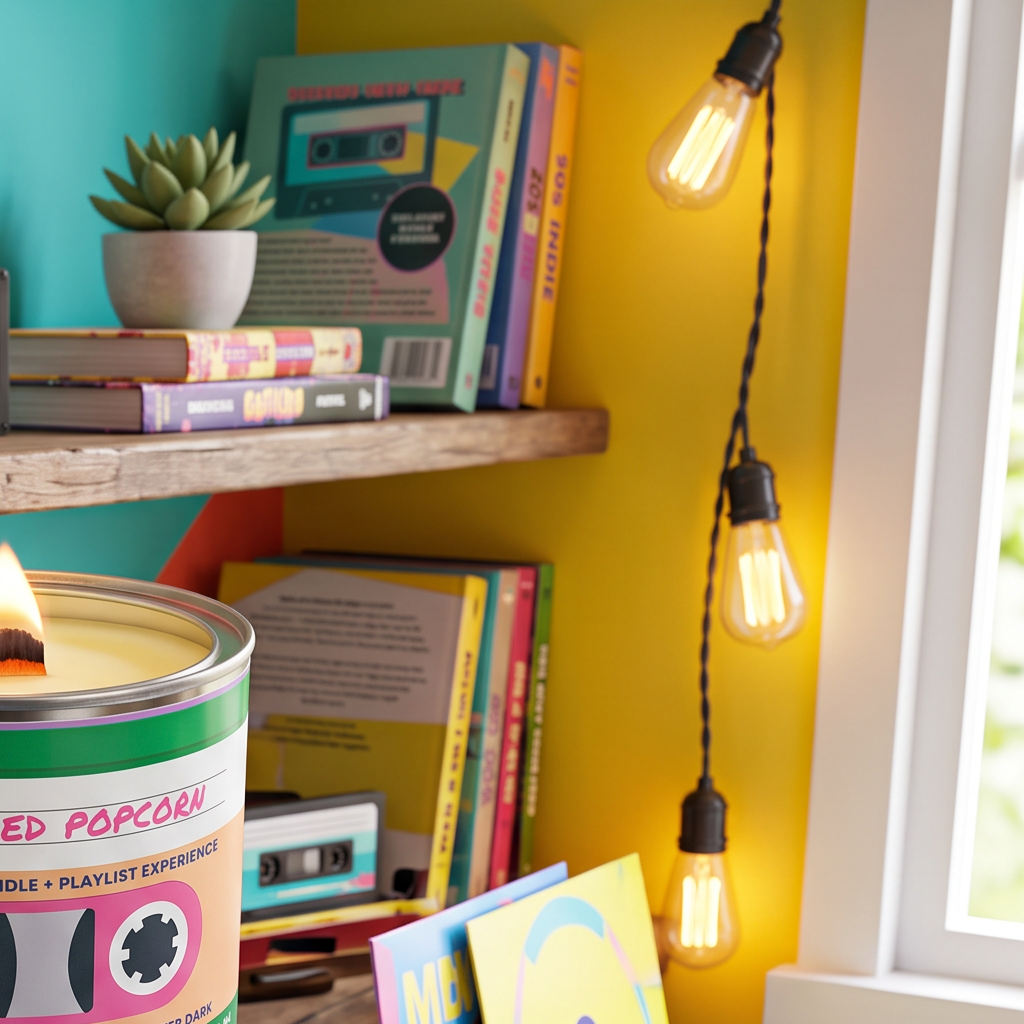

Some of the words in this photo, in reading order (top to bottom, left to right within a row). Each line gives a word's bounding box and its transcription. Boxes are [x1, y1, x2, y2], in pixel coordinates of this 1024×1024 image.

[65, 785, 206, 839] POPCORN
[59, 867, 137, 890] PLAYLIST
[142, 838, 218, 877] EXPERIENCE
